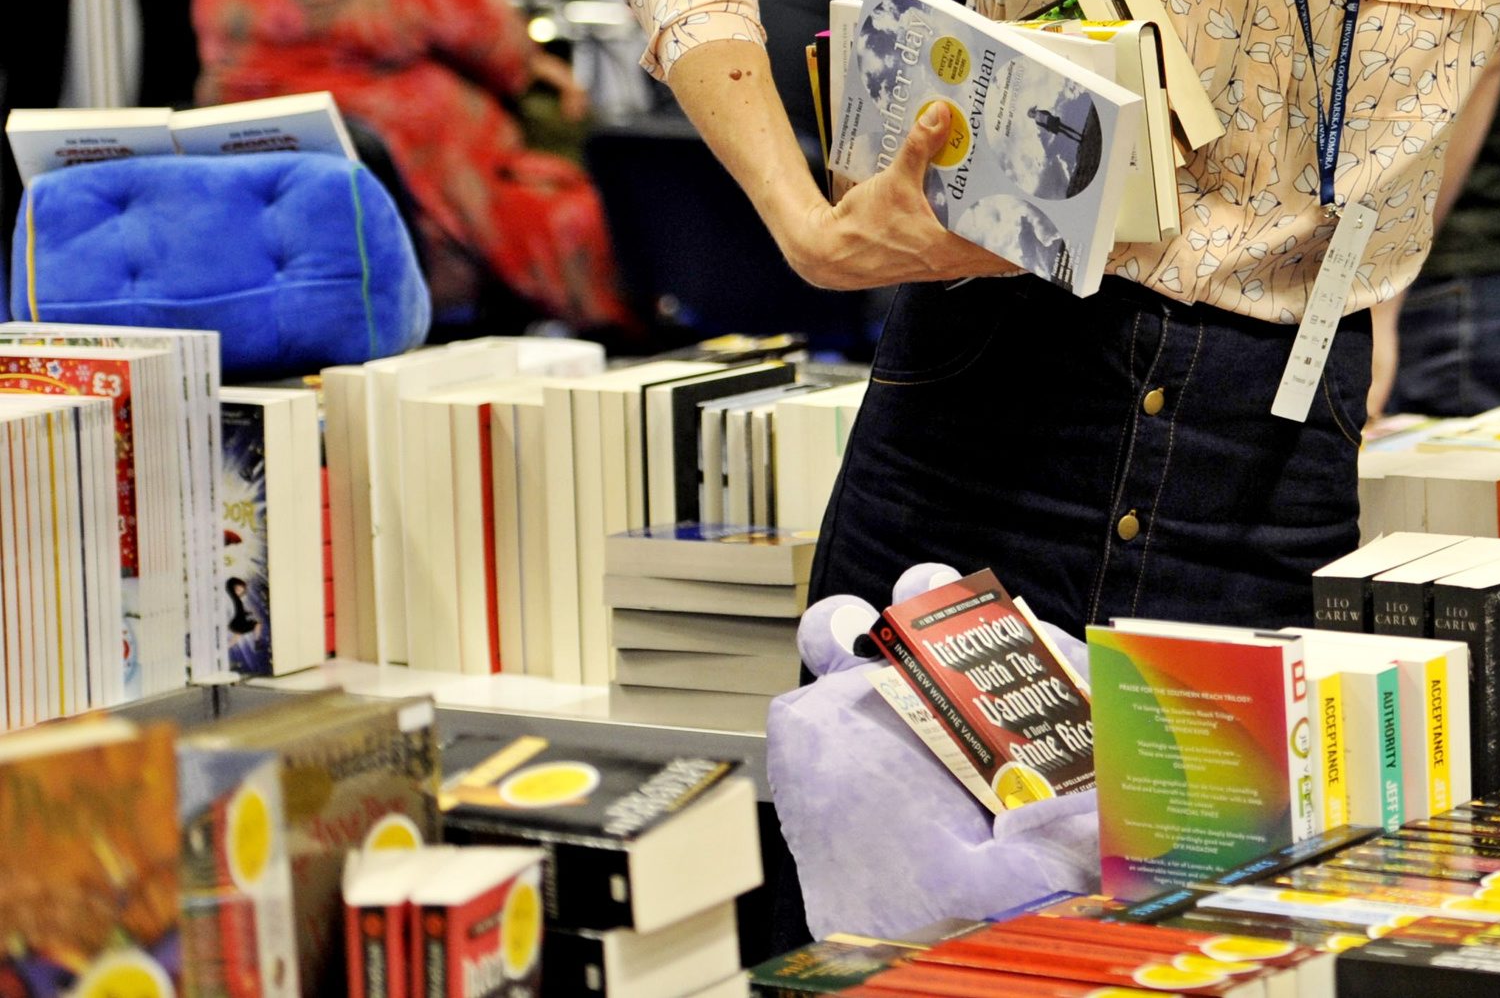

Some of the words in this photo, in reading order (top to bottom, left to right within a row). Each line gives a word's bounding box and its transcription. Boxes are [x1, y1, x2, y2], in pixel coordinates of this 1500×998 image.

[893, 12, 934, 70] day
[941, 36, 953, 54] day
[1339, 19, 1353, 64] HRVATSKA
[935, 52, 948, 77] every
[1002, 59, 1016, 91] bestselling
[855, 97, 864, 112] face?
[999, 89, 1008, 106] Times
[1331, 64, 1347, 130] GOSPODARSKA
[852, 112, 860, 127] same
[877, 68, 913, 176] nother
[993, 118, 1002, 132] New
[996, 105, 1005, 119] York
[833, 149, 842, 165] Would
[839, 113, 851, 139] recognize
[1003, 118, 1013, 137] author
[1324, 130, 1340, 169] KOMORA
[92, 371, 123, 398] £3
[923, 615, 934, 623] NEW
[933, 611, 945, 620] YORK
[943, 606, 957, 615] TIMES
[955, 597, 980, 611] BESTSELLING
[979, 592, 994, 603] AUTHOR
[1315, 610, 1361, 622] CAREW
[1326, 598, 1349, 608] LEO
[1386, 602, 1409, 613] LEO
[1446, 607, 1468, 618] LEO
[1375, 614, 1420, 627] CAREW
[1435, 618, 1479, 632] CAREW
[921, 614, 1025, 667] Interview
[965, 661, 1015, 693] With
[1006, 652, 1044, 677] The
[894, 643, 931, 690] INTERVIEW
[929, 687, 951, 715] WITH
[946, 708, 963, 728] THE
[959, 724, 992, 765] VAMPIRE
[972, 675, 1071, 725] Vampire
[1119, 684, 1139, 692] PRAISE
[1167, 689, 1200, 698] SOUTHERN
[1201, 692, 1222, 700] REACH
[1023, 727, 1032, 739] A
[1033, 721, 1052, 737] Novel
[1214, 712, 1233, 721] Trilogy
[1383, 691, 1396, 769] AUTHORITY
[1432, 679, 1444, 770] ACCEPTANCE
[1009, 736, 1064, 768] Anne
[1056, 720, 1094, 757] Rice
[1325, 697, 1339, 787] ACCEPTANCE
[1386, 780, 1399, 812] JEFF
